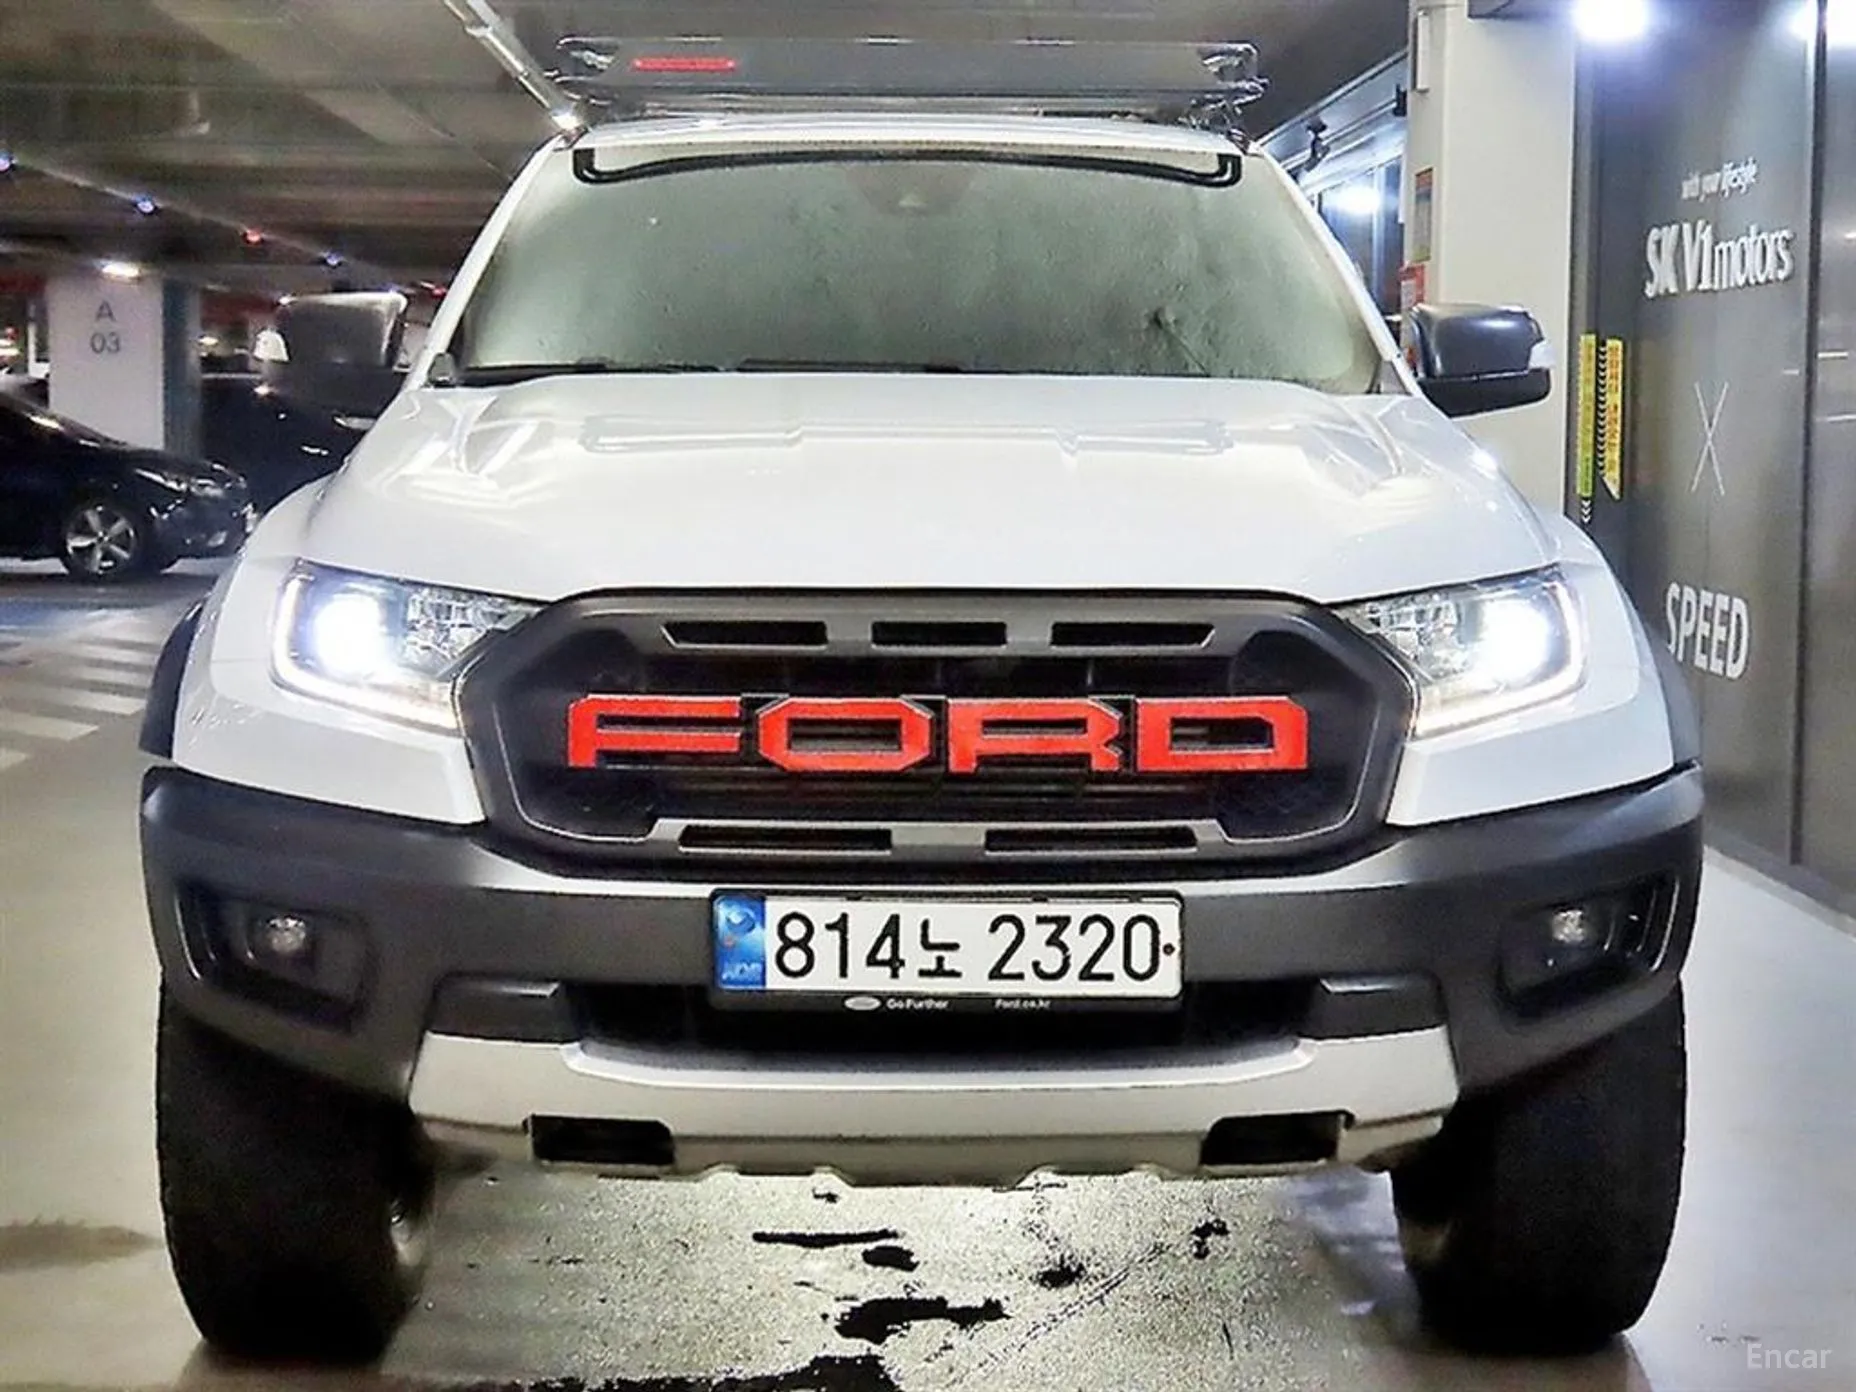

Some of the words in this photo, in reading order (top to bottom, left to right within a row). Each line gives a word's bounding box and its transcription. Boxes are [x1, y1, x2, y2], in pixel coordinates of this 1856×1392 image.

[1645, 224, 1679, 299] SK
[90, 331, 121, 355] 03
[95, 300, 117, 322] A
[1666, 581, 1749, 679] SPEED
[567, 694, 1307, 773] FORD
[774, 911, 963, 980] 814노
[987, 912, 1161, 982] 2320
